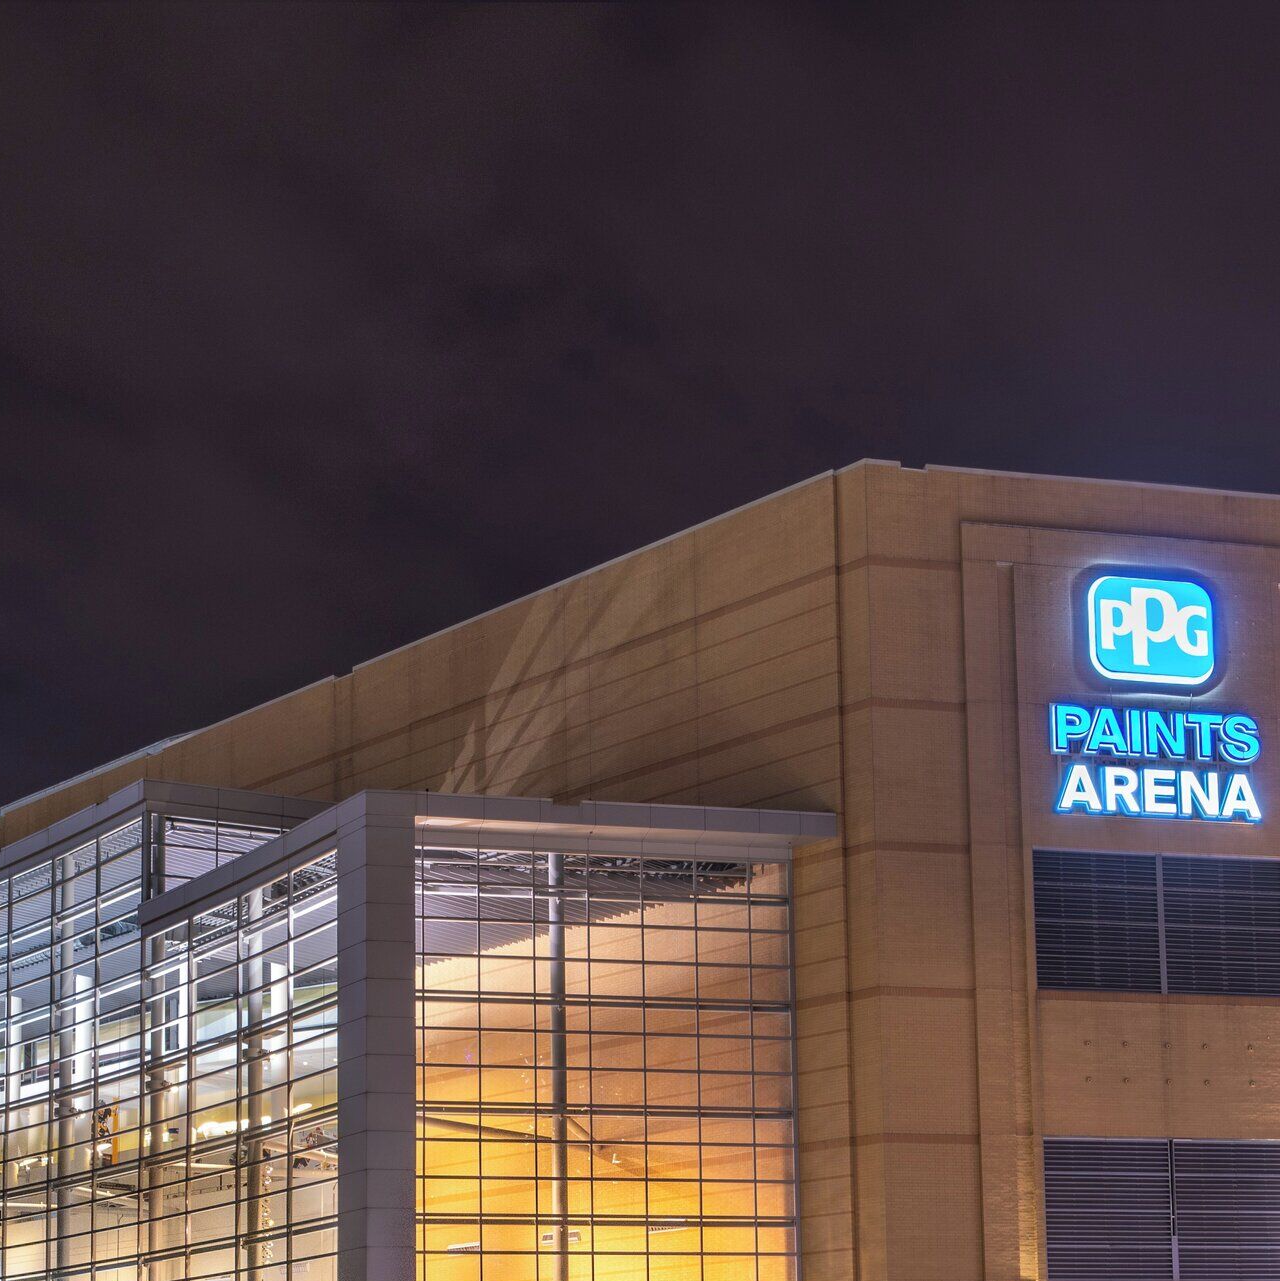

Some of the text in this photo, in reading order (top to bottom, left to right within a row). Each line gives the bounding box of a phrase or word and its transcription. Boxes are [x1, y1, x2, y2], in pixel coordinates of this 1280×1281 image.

[1099, 586, 1210, 667] PPG
[1052, 703, 1261, 764] PAINTS
[1056, 764, 1262, 823] ARENA
